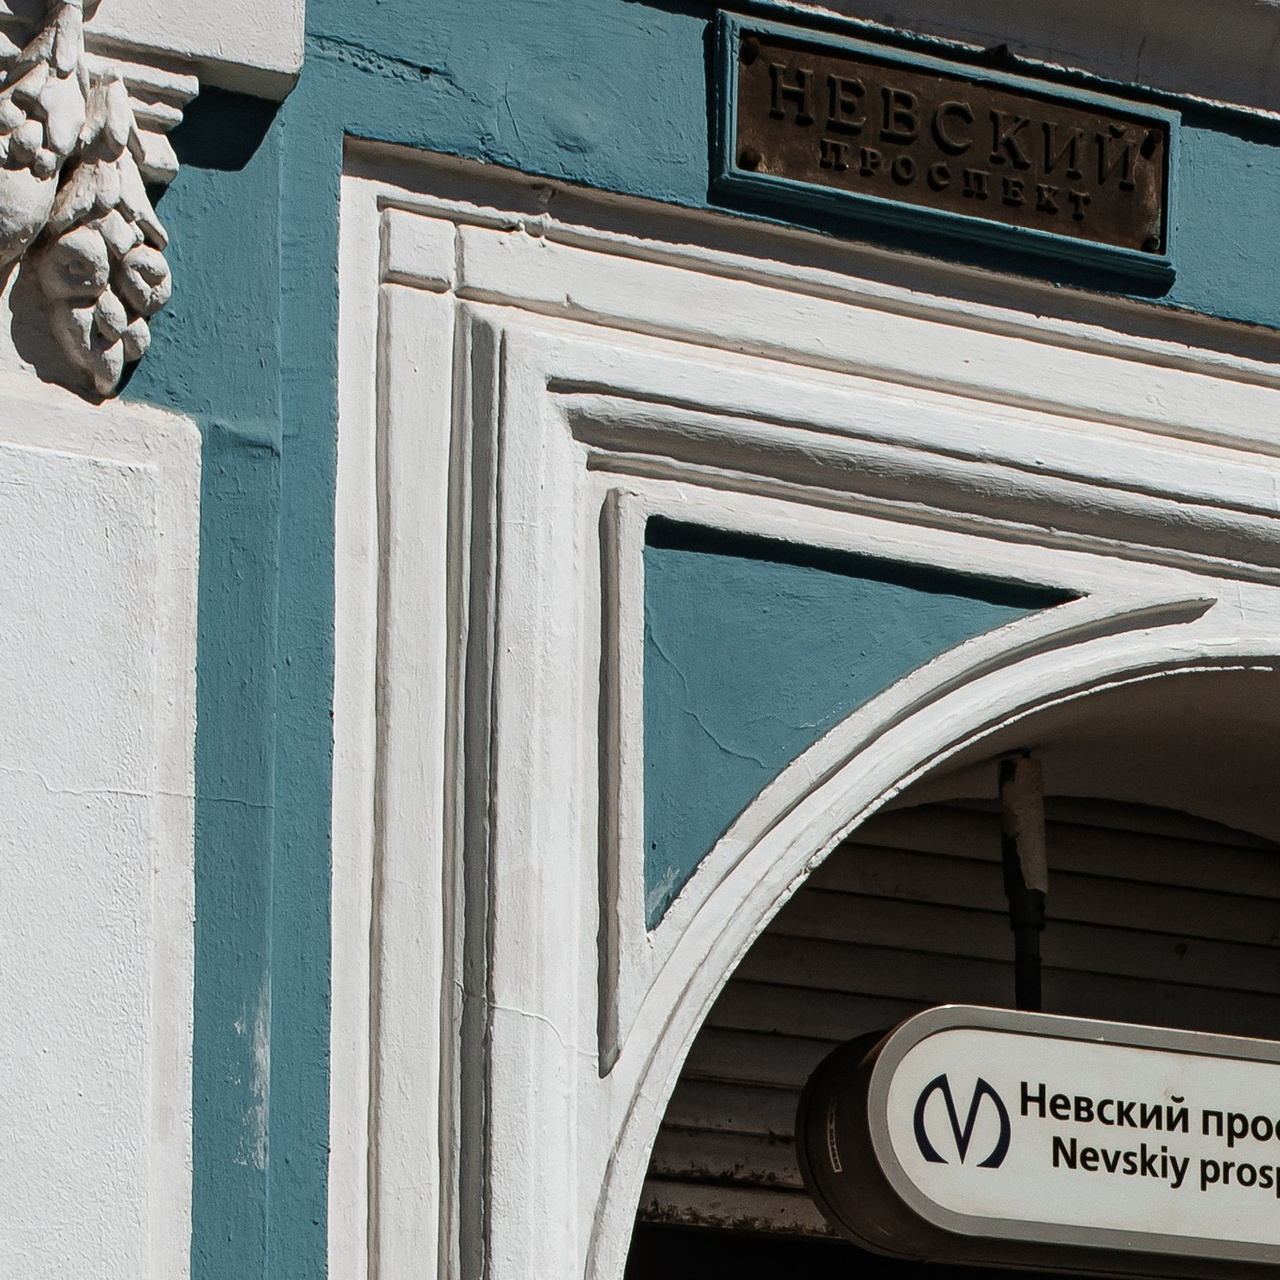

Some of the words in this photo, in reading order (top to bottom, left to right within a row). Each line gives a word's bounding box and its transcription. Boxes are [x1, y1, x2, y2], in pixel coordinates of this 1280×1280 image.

[768, 62, 1137, 193] НЕВСКИЙ
[819, 138, 1091, 221] ПРОСПЕКТ
[1020, 1081, 1190, 1134] Невский
[1052, 1136, 1191, 1188] Nevskiy
